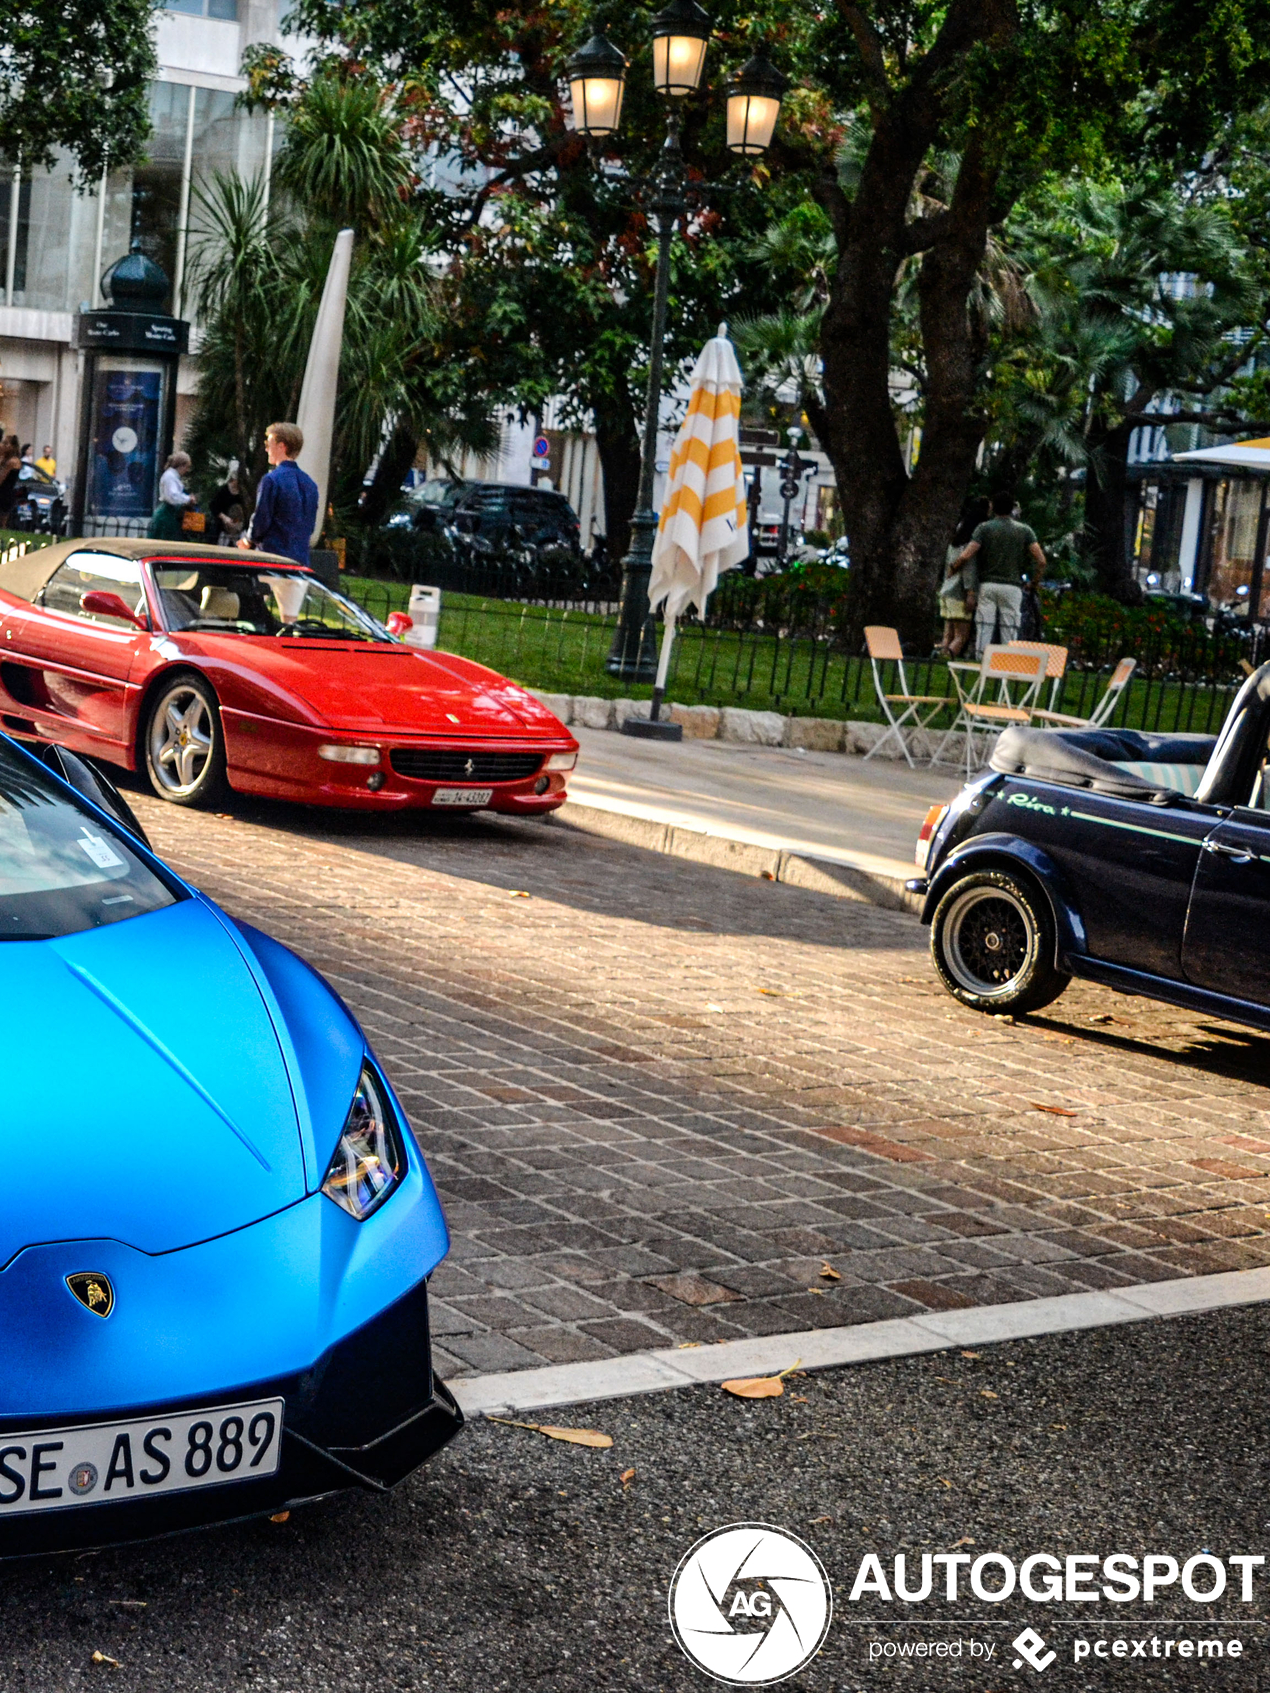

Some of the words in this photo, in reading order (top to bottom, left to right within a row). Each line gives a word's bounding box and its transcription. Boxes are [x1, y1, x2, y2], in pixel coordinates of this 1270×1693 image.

[1007, 793, 1056, 815] Riva
[103, 1427, 172, 1492] AS
[184, 1411, 275, 1478] 889
